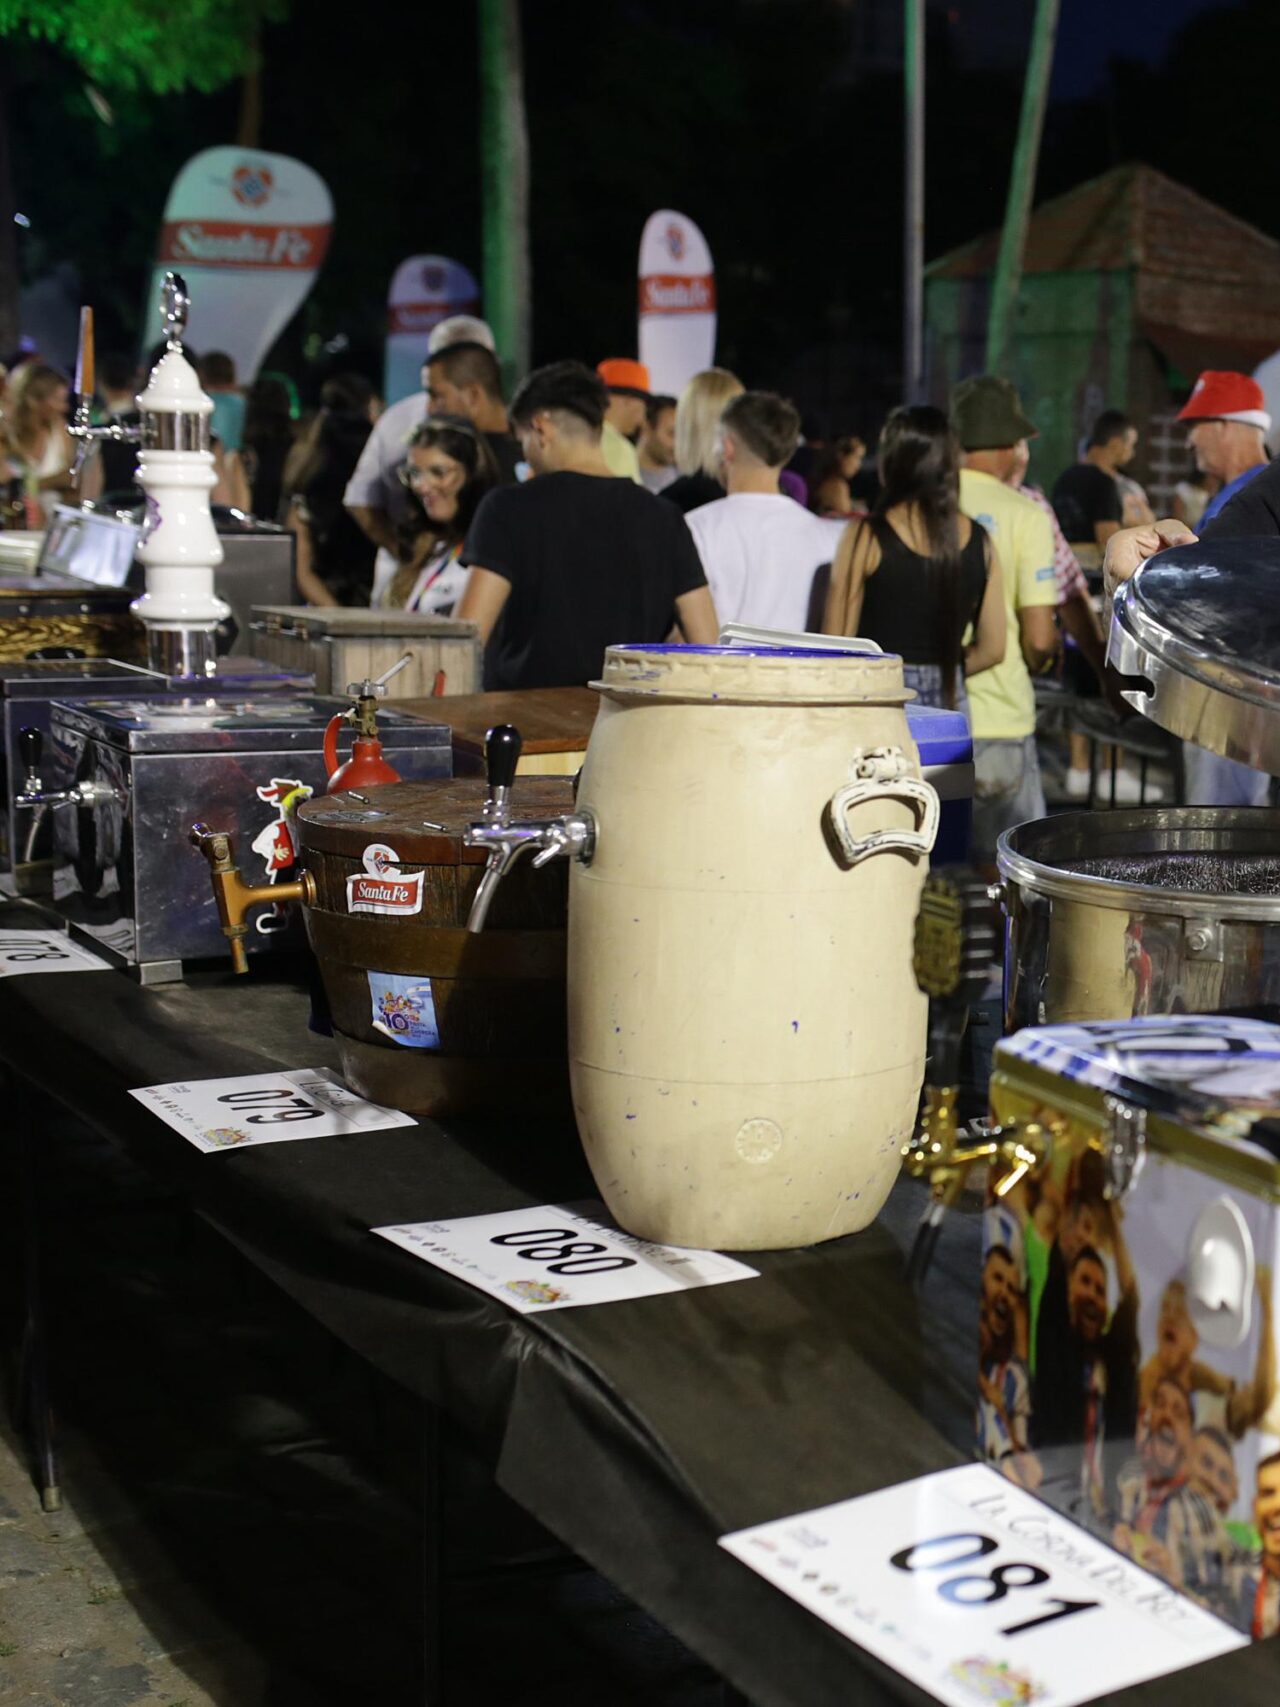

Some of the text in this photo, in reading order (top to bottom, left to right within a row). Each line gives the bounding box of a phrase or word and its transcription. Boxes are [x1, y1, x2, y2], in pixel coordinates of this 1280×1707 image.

[172, 224, 312, 264] Santa Fe
[358, 881, 409, 902] Santa Fe
[217, 1089, 325, 1124] 079
[490, 1228, 638, 1275] 080
[890, 1533, 1101, 1636] 081
